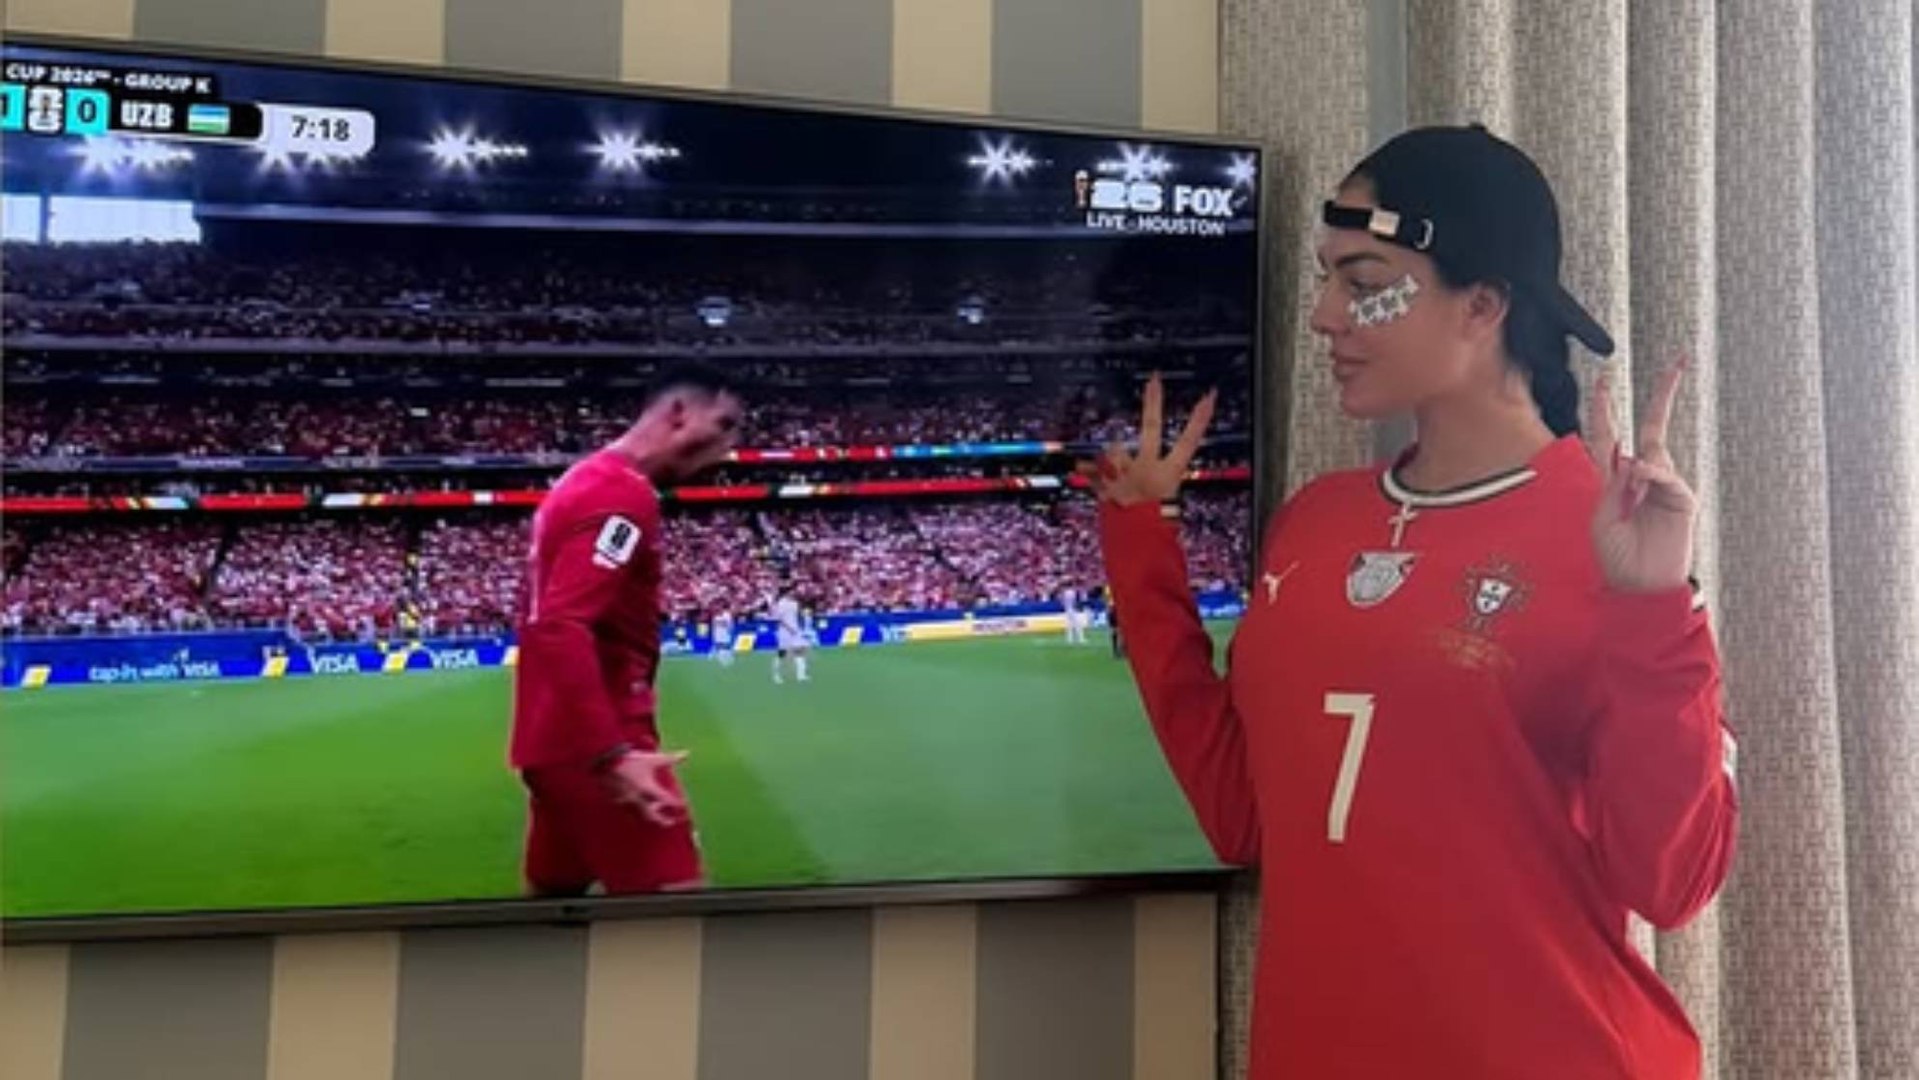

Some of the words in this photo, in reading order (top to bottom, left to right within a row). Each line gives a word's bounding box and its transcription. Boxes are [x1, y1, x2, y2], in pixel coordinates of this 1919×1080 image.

[6, 63, 46, 79] CUP
[124, 73, 192, 91] GROUP
[195, 78, 211, 93] K
[78, 97, 96, 124] 0
[121, 100, 173, 127] UZB
[291, 115, 350, 141] 7:18
[1175, 185, 1233, 216] FOX
[1087, 212, 1124, 231] LIVE
[1139, 215, 1225, 236] HOUSTON
[312, 652, 359, 673] VISA
[433, 649, 479, 668] VISA
[1324, 692, 1376, 842] 7
